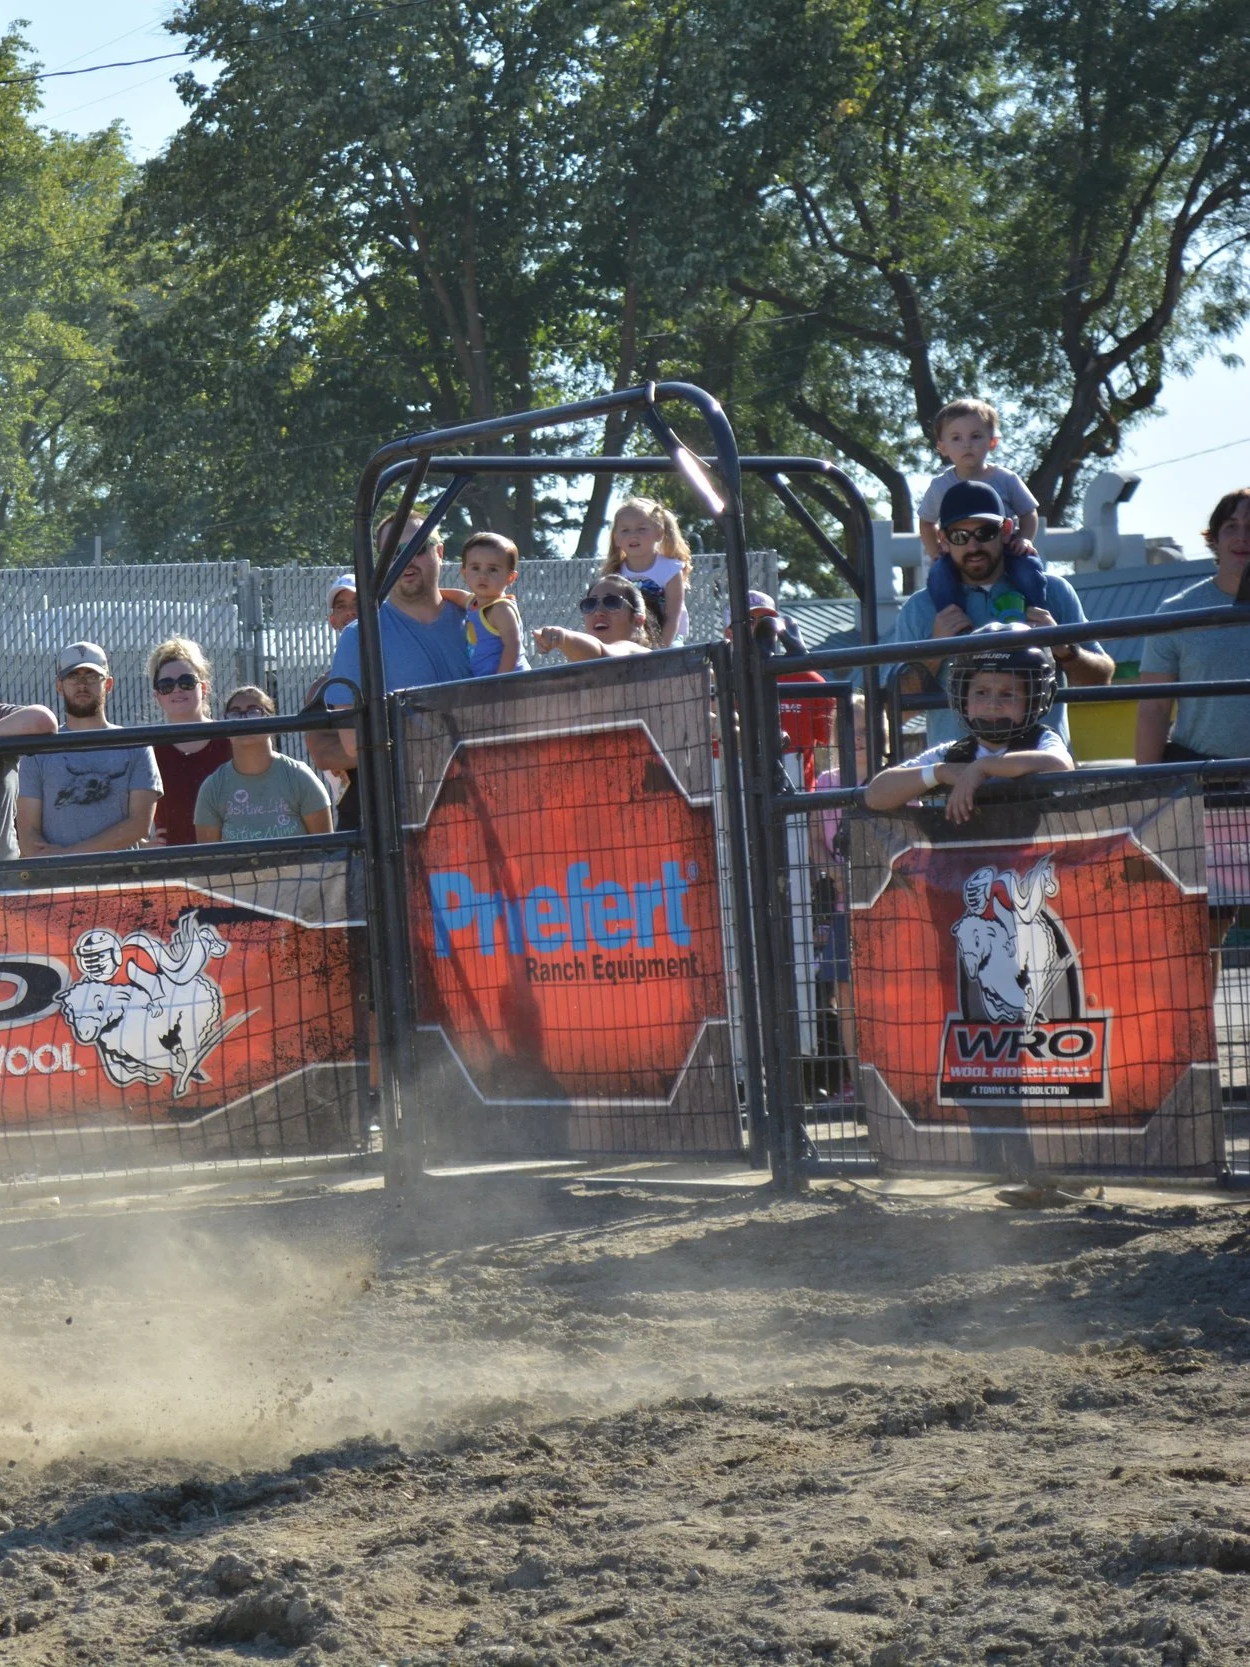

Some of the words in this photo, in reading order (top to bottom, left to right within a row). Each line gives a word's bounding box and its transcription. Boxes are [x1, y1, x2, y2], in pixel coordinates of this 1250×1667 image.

[429, 861, 691, 958] Priefert
[525, 955, 586, 983] Ranch
[591, 951, 699, 985] Equipment
[954, 1026, 1096, 1062] WRO
[950, 1066, 990, 1078] WOOL
[992, 1066, 1048, 1078] RIDERS
[1052, 1067, 1092, 1078] ONLY
[979, 1086, 1007, 1095] TOMMY
[1019, 1086, 1070, 1095] PRODUCTION
